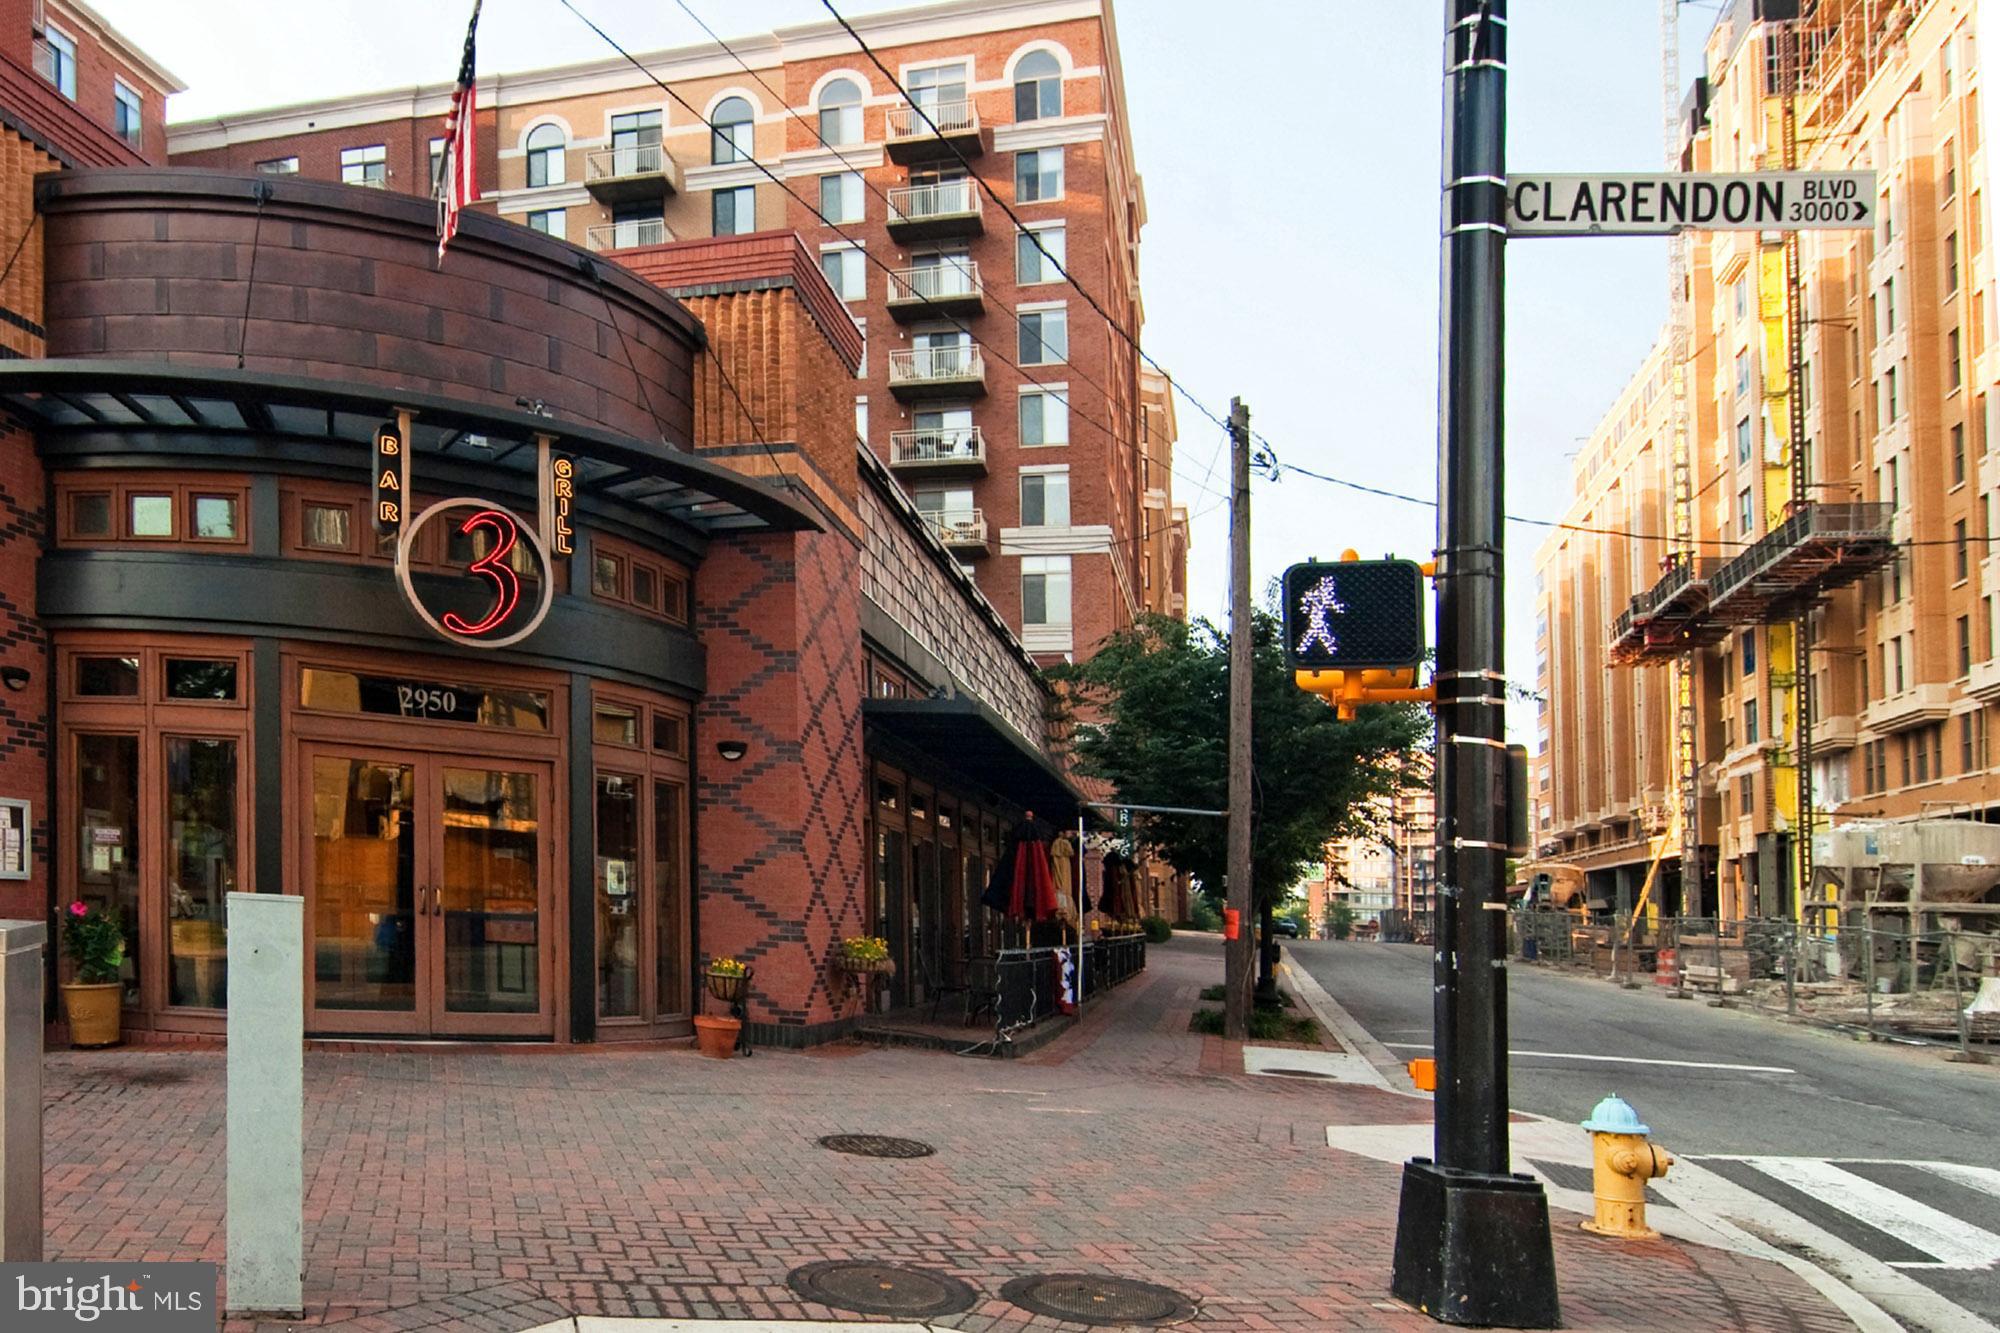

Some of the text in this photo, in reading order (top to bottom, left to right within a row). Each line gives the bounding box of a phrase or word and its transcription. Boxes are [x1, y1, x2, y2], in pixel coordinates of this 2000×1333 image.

[1514, 180, 1857, 224] CLARENDON BLVD
[1789, 201, 1849, 222] 3000
[379, 435, 399, 522] BAR
[554, 459, 573, 554] GRILL
[443, 510, 519, 634] 3
[400, 686, 457, 714] 2950
